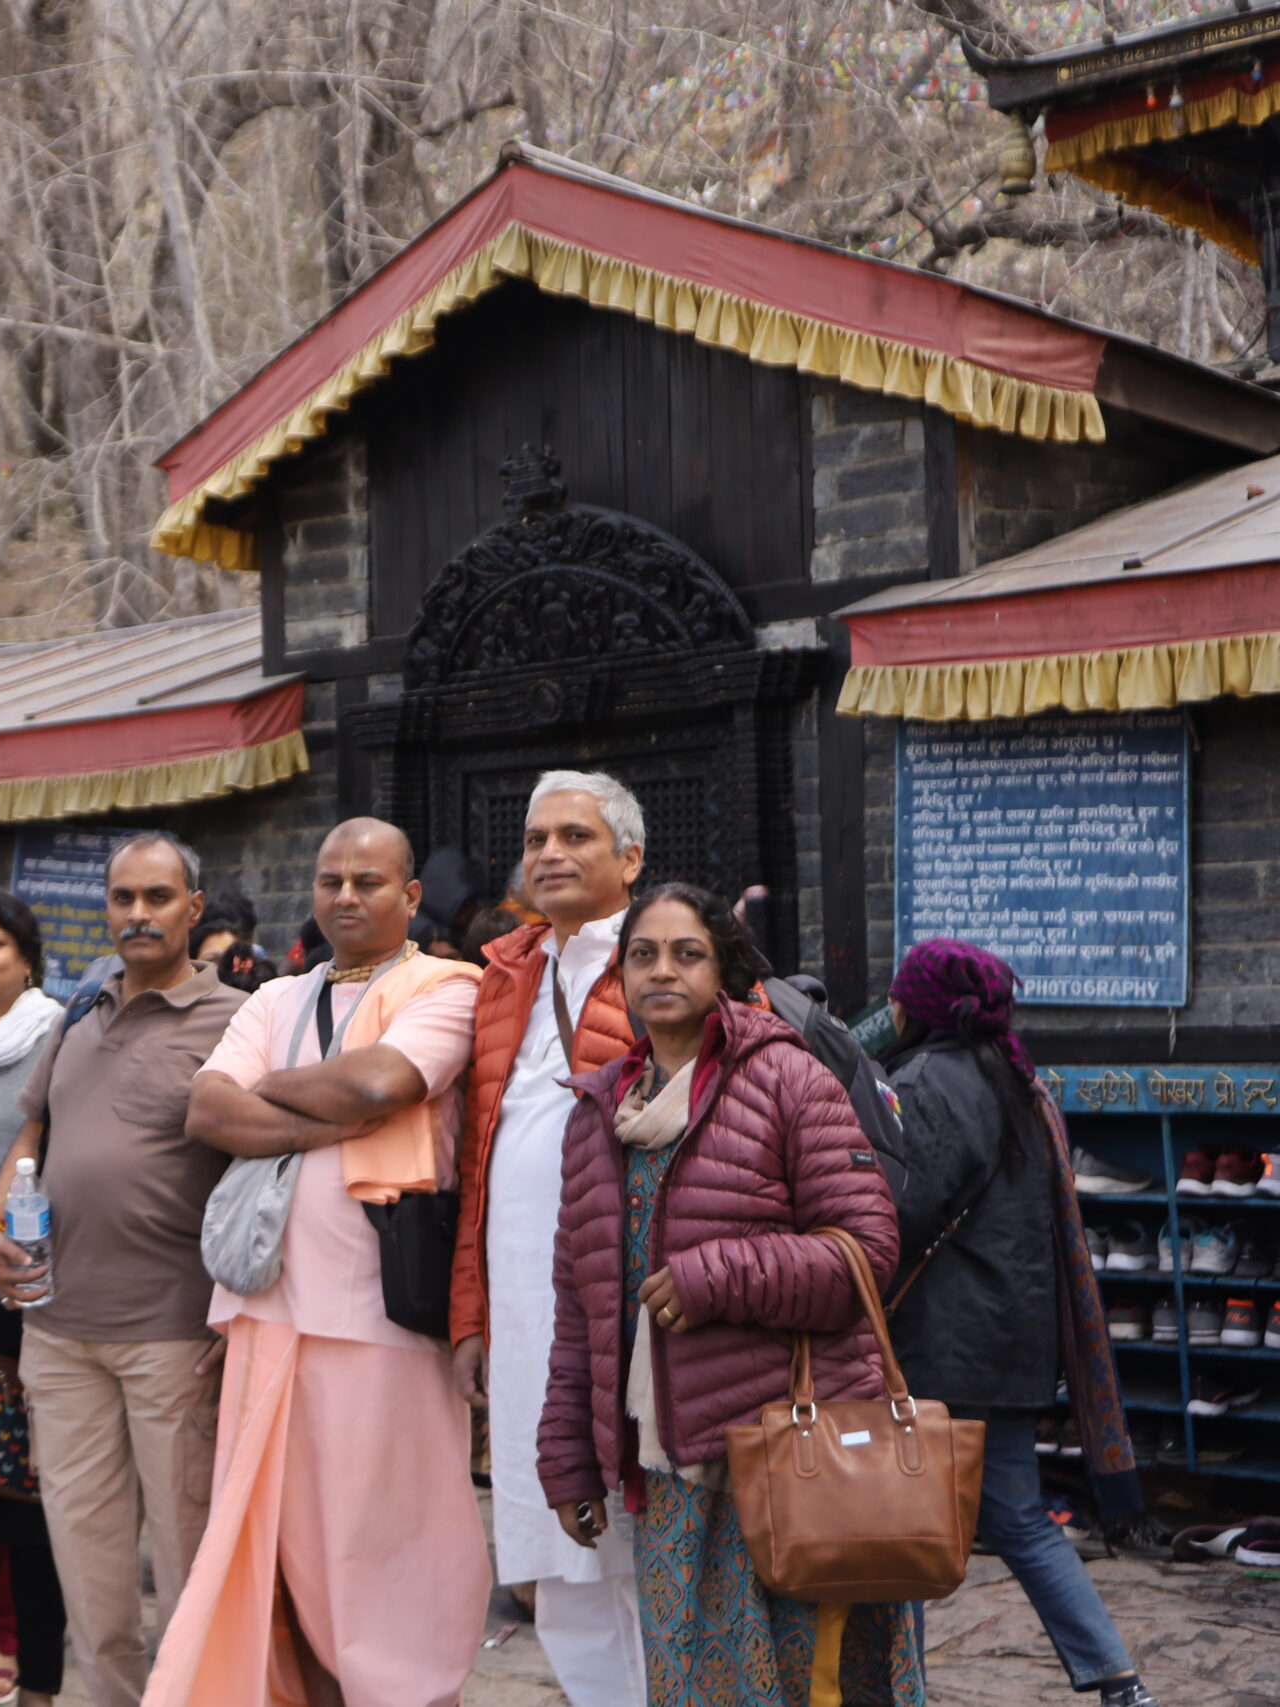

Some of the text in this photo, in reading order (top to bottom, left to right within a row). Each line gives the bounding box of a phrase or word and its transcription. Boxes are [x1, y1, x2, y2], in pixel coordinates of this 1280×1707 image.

[1023, 978, 1160, 998] PHOTOGRAPHY
[1147, 1070, 1206, 1105] पोखरा
[1226, 1311, 1250, 1323] FILA
